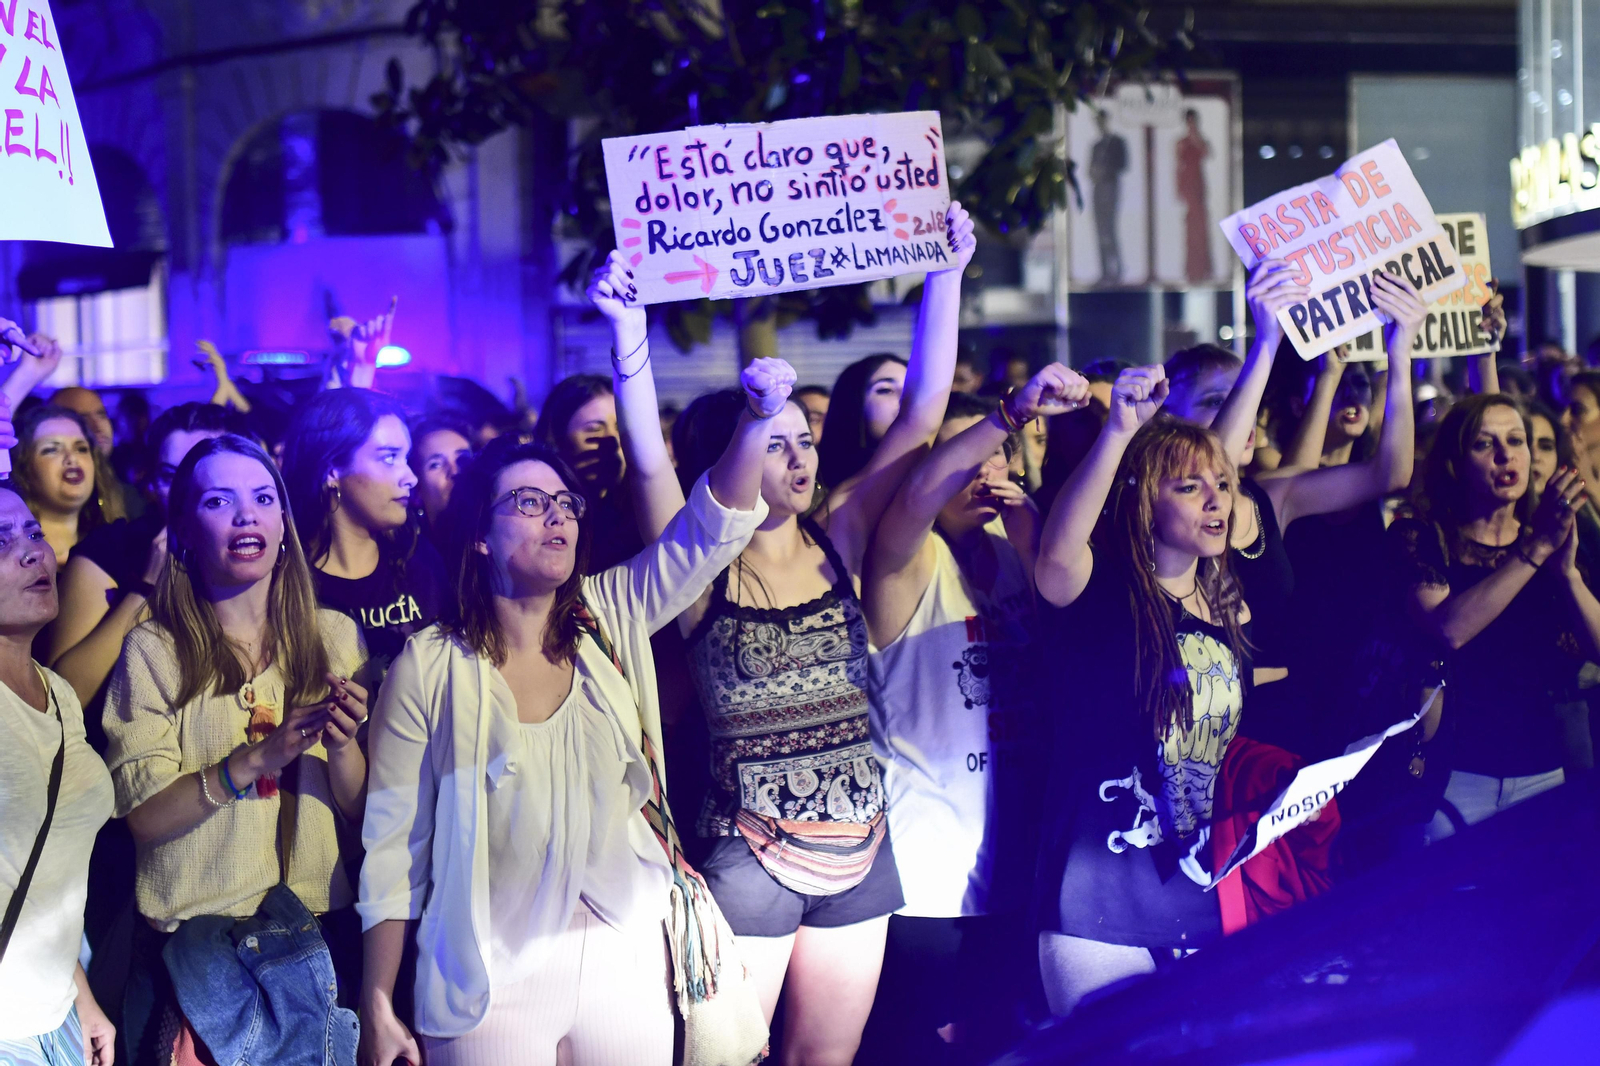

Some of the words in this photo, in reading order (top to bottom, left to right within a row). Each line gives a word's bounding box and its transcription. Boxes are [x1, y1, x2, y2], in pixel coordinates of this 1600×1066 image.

[24, 8, 56, 51] EL
[15, 56, 60, 109] LA
[0, 109, 74, 186] EL!!
[744, 131, 813, 170] claro
[825, 137, 890, 176] que,
[635, 181, 723, 215] dolor,
[730, 179, 774, 204] no
[788, 164, 871, 200] sintió
[1239, 191, 1339, 261] BASTA
[1340, 160, 1391, 208] DE
[647, 217, 751, 254] Ricardo
[759, 201, 887, 243] González
[1284, 202, 1422, 287] JUSTICIA
[730, 248, 835, 287] JUEZ
[1271, 781, 1349, 826] NOSOT
